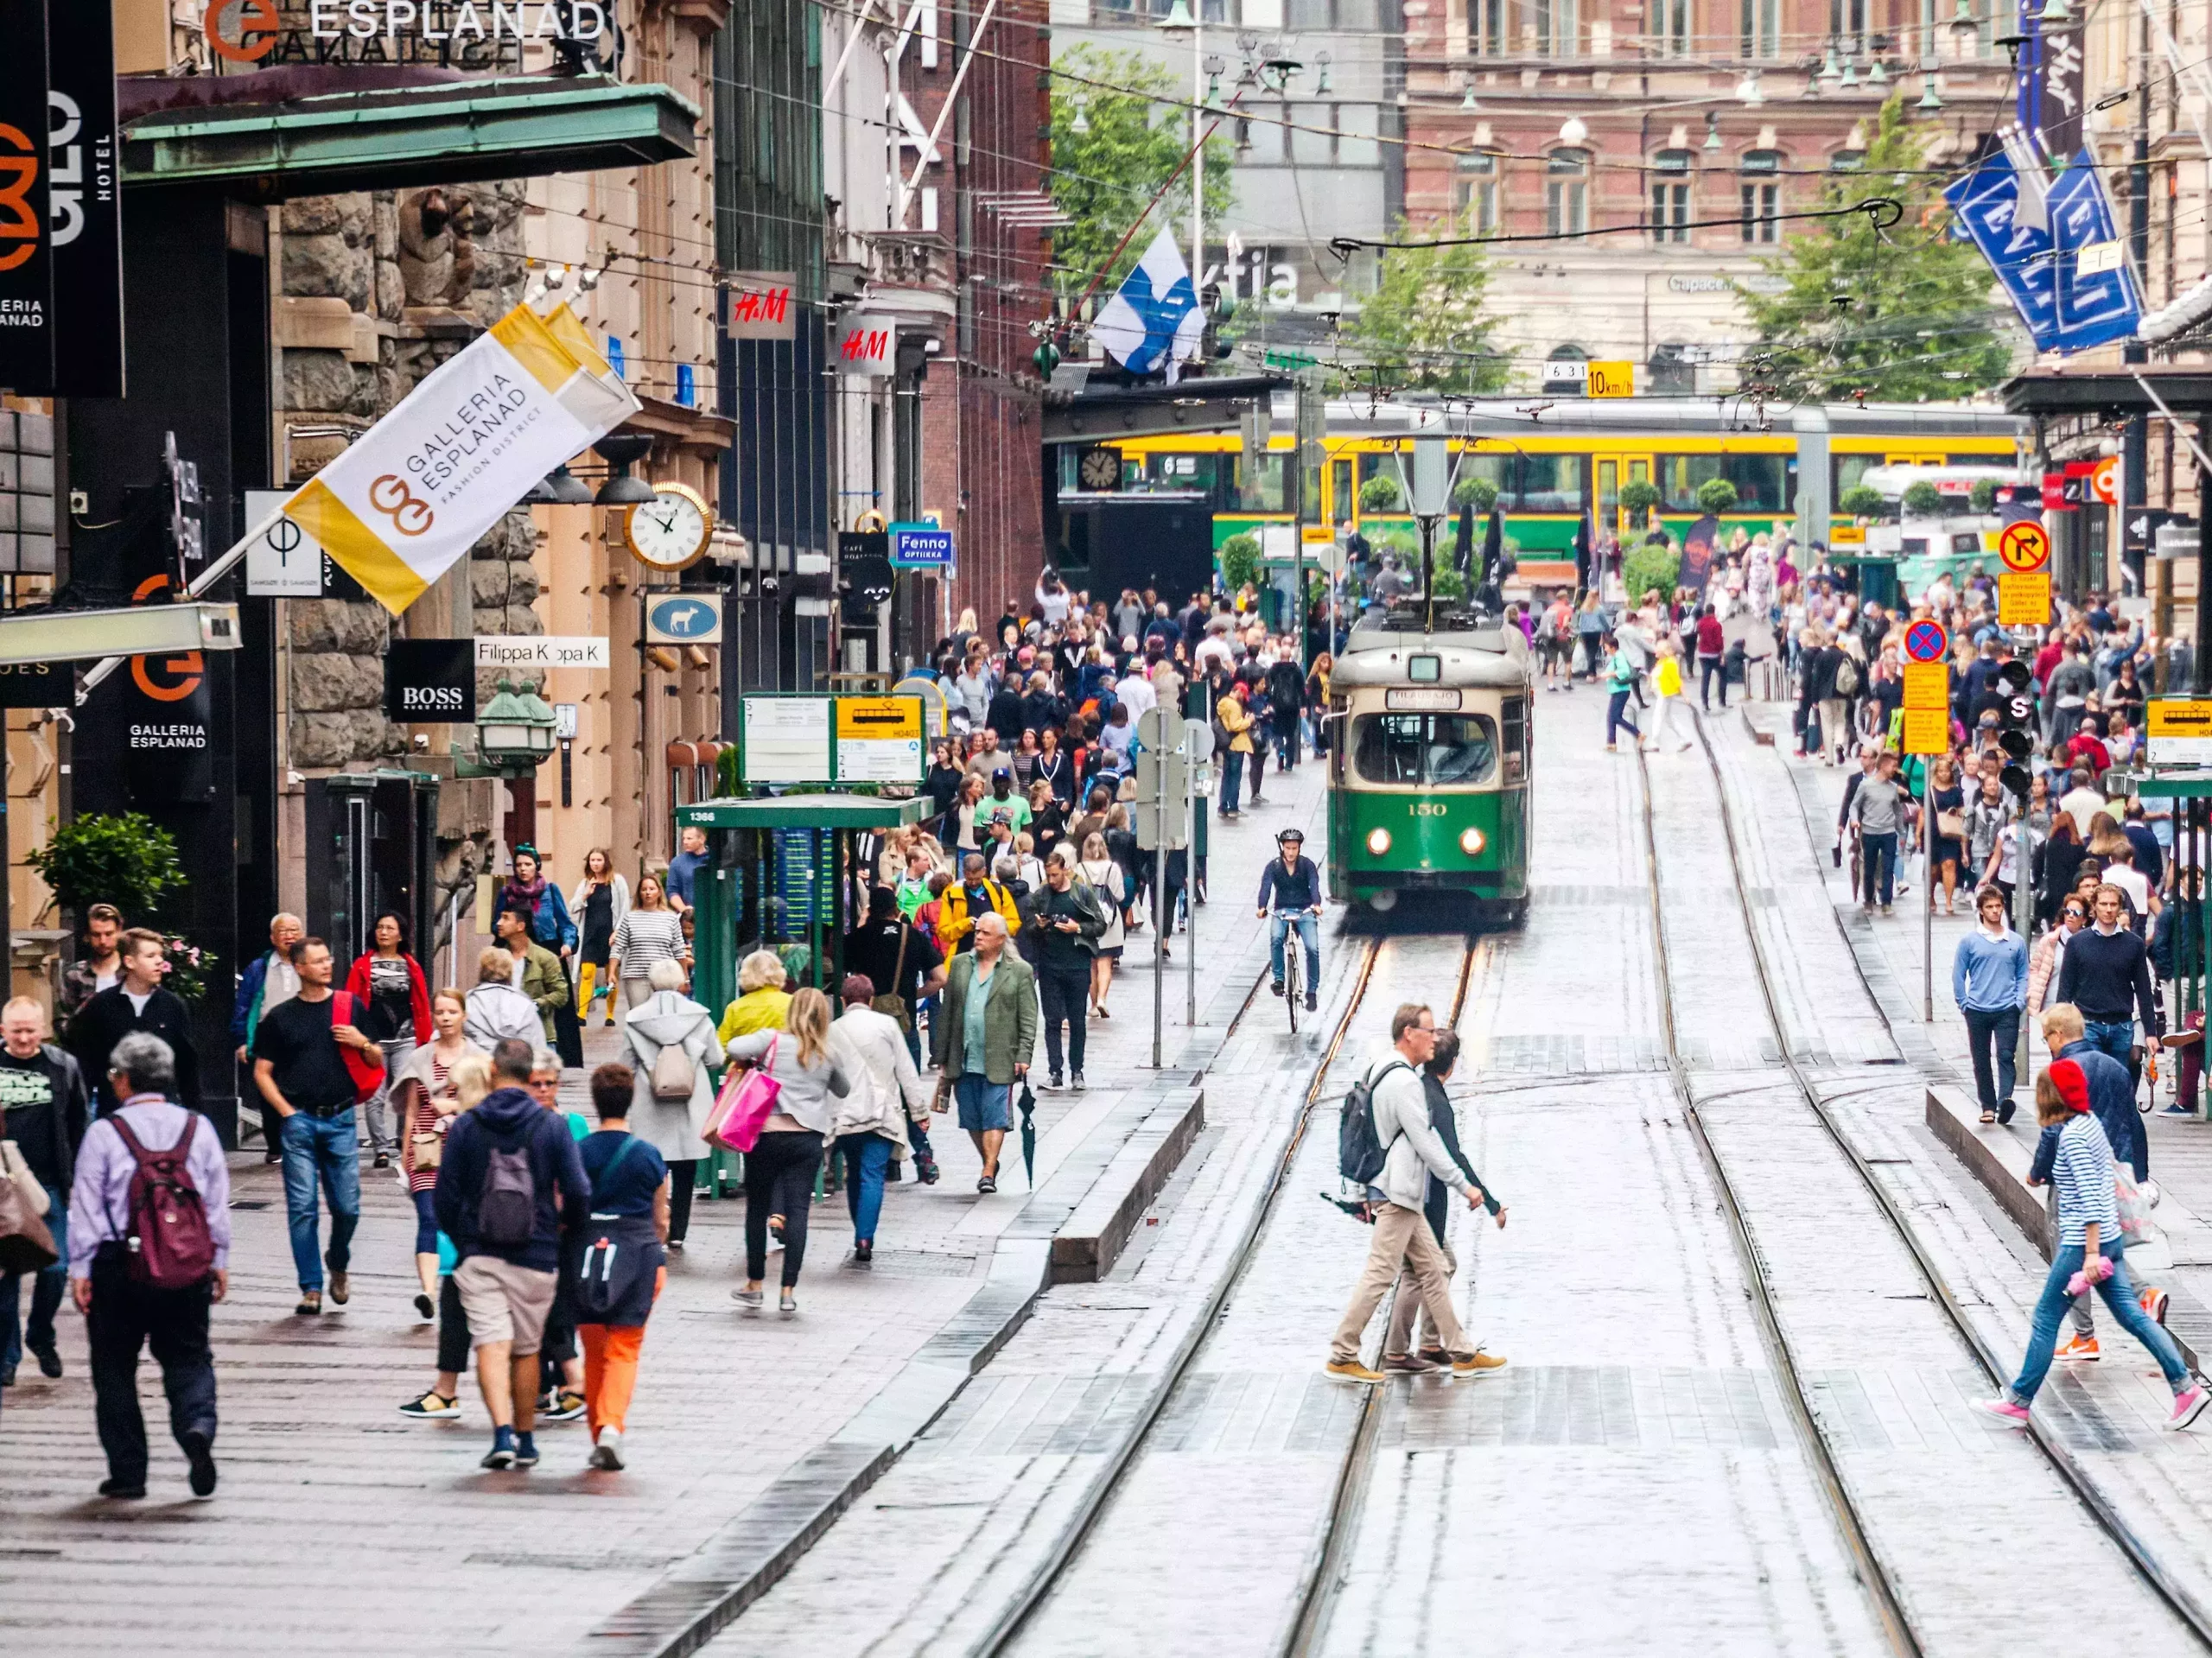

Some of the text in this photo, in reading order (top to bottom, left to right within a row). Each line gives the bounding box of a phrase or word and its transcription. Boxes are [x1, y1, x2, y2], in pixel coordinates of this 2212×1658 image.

[311, 0, 606, 40] ESPLANAD
[96, 135, 111, 201] HOTEL
[734, 287, 790, 324] H&M
[841, 328, 888, 361] H&M
[1590, 372, 1632, 394] 10 km/h
[407, 374, 511, 473] GALLERIA
[422, 389, 525, 490] ESPLANAD
[442, 407, 542, 505] FASHION DISTRICT
[901, 536, 947, 549] Fenno
[479, 644, 549, 664] Filippa K
[588, 645, 598, 661] K
[403, 688, 463, 704] BOSS
[130, 725, 206, 736] GALLERIA
[130, 737, 206, 748] ESPLANAD
[690, 812, 715, 821] 1366
[1408, 804, 1447, 816] 150
